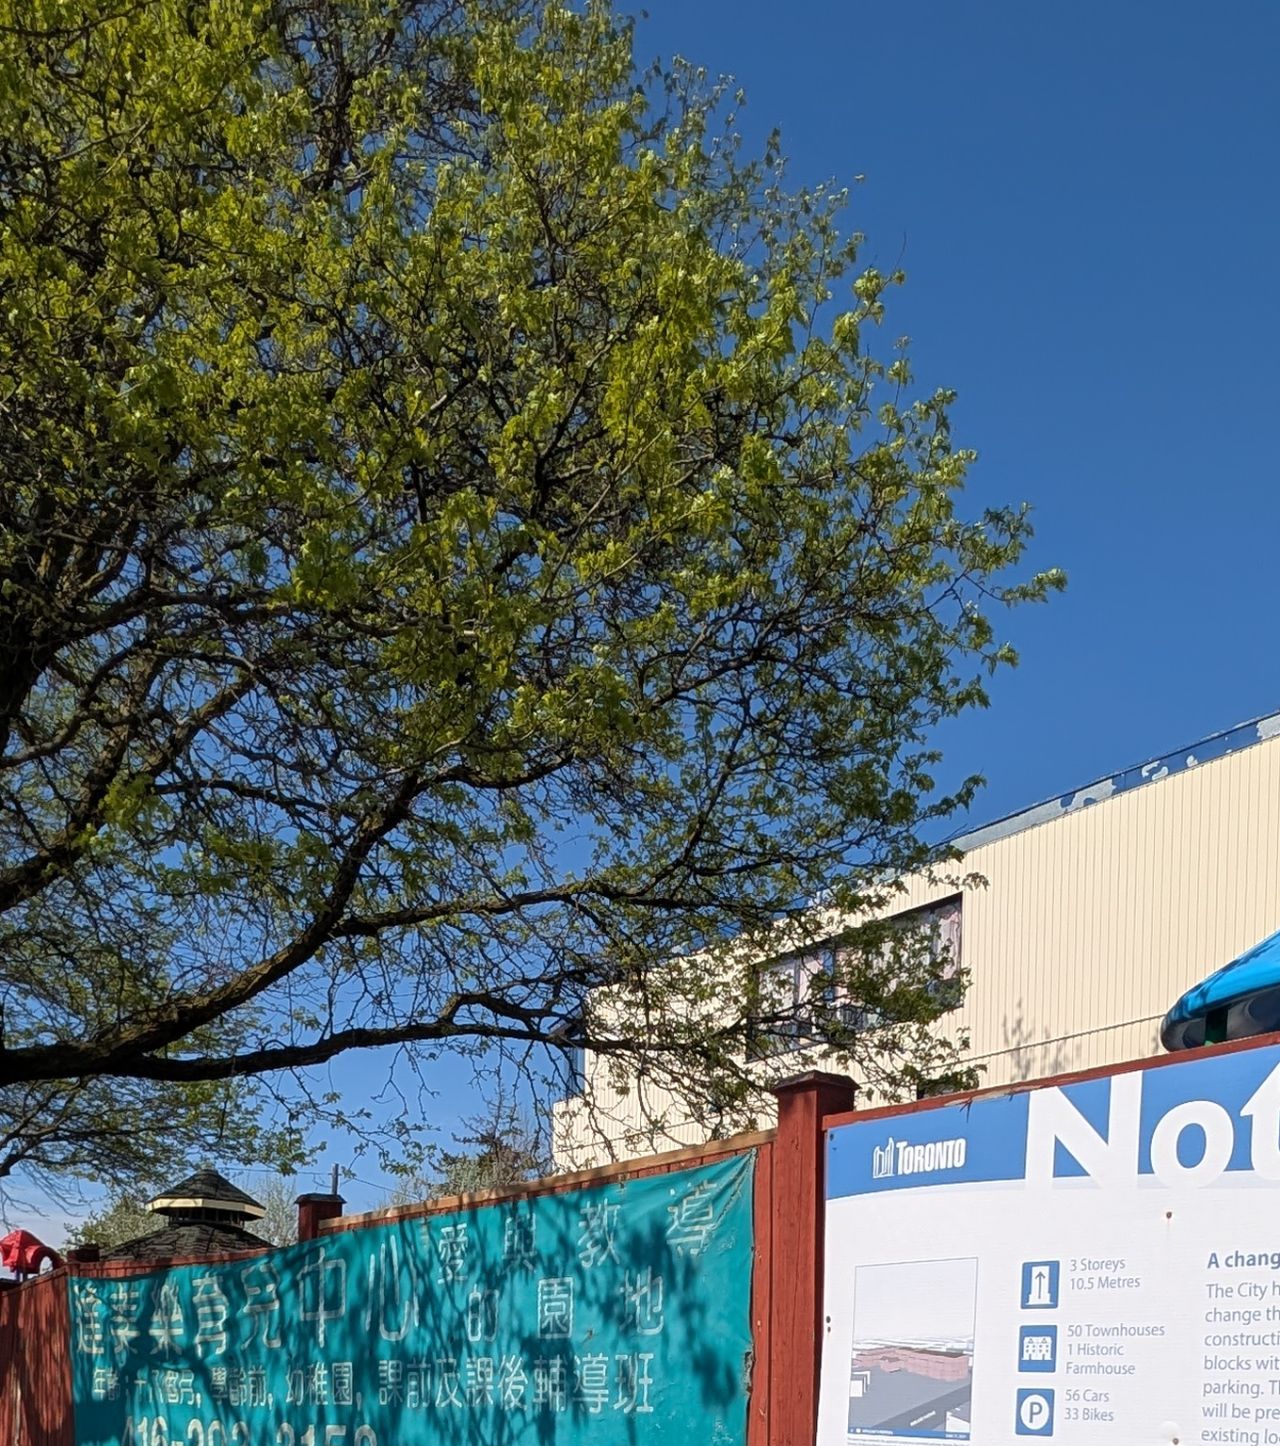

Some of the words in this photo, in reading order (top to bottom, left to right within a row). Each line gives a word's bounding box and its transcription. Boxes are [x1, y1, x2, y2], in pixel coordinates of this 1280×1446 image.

[896, 1138, 967, 1175] TORONTO
[1070, 1259, 1077, 1272] 3
[1080, 1258, 1126, 1273] Storeys
[1207, 1252, 1220, 1269] A
[1070, 1277, 1094, 1290] 10.5
[1097, 1276, 1141, 1290] Metres
[1205, 1283, 1234, 1299] The
[1237, 1282, 1268, 1301] City
[467, 1265, 665, 1342] 的園地
[1205, 1307, 1262, 1326] change
[1067, 1324, 1083, 1337] 50
[1085, 1323, 1166, 1337] Townhouses
[1068, 1344, 1074, 1356] 1
[1077, 1343, 1125, 1356] Historic
[1065, 1362, 1136, 1375] Farmhouse
[1203, 1355, 1252, 1371] blocks
[1065, 1389, 1080, 1402] 56
[1083, 1389, 1110, 1402] Cars
[1203, 1379, 1264, 1399] parking.
[1029, 1402, 1043, 1423] P
[1064, 1408, 1079, 1420] 33
[1082, 1408, 1114, 1421] Bikes
[1201, 1403, 1227, 1418] will
[1231, 1403, 1251, 1419] be
